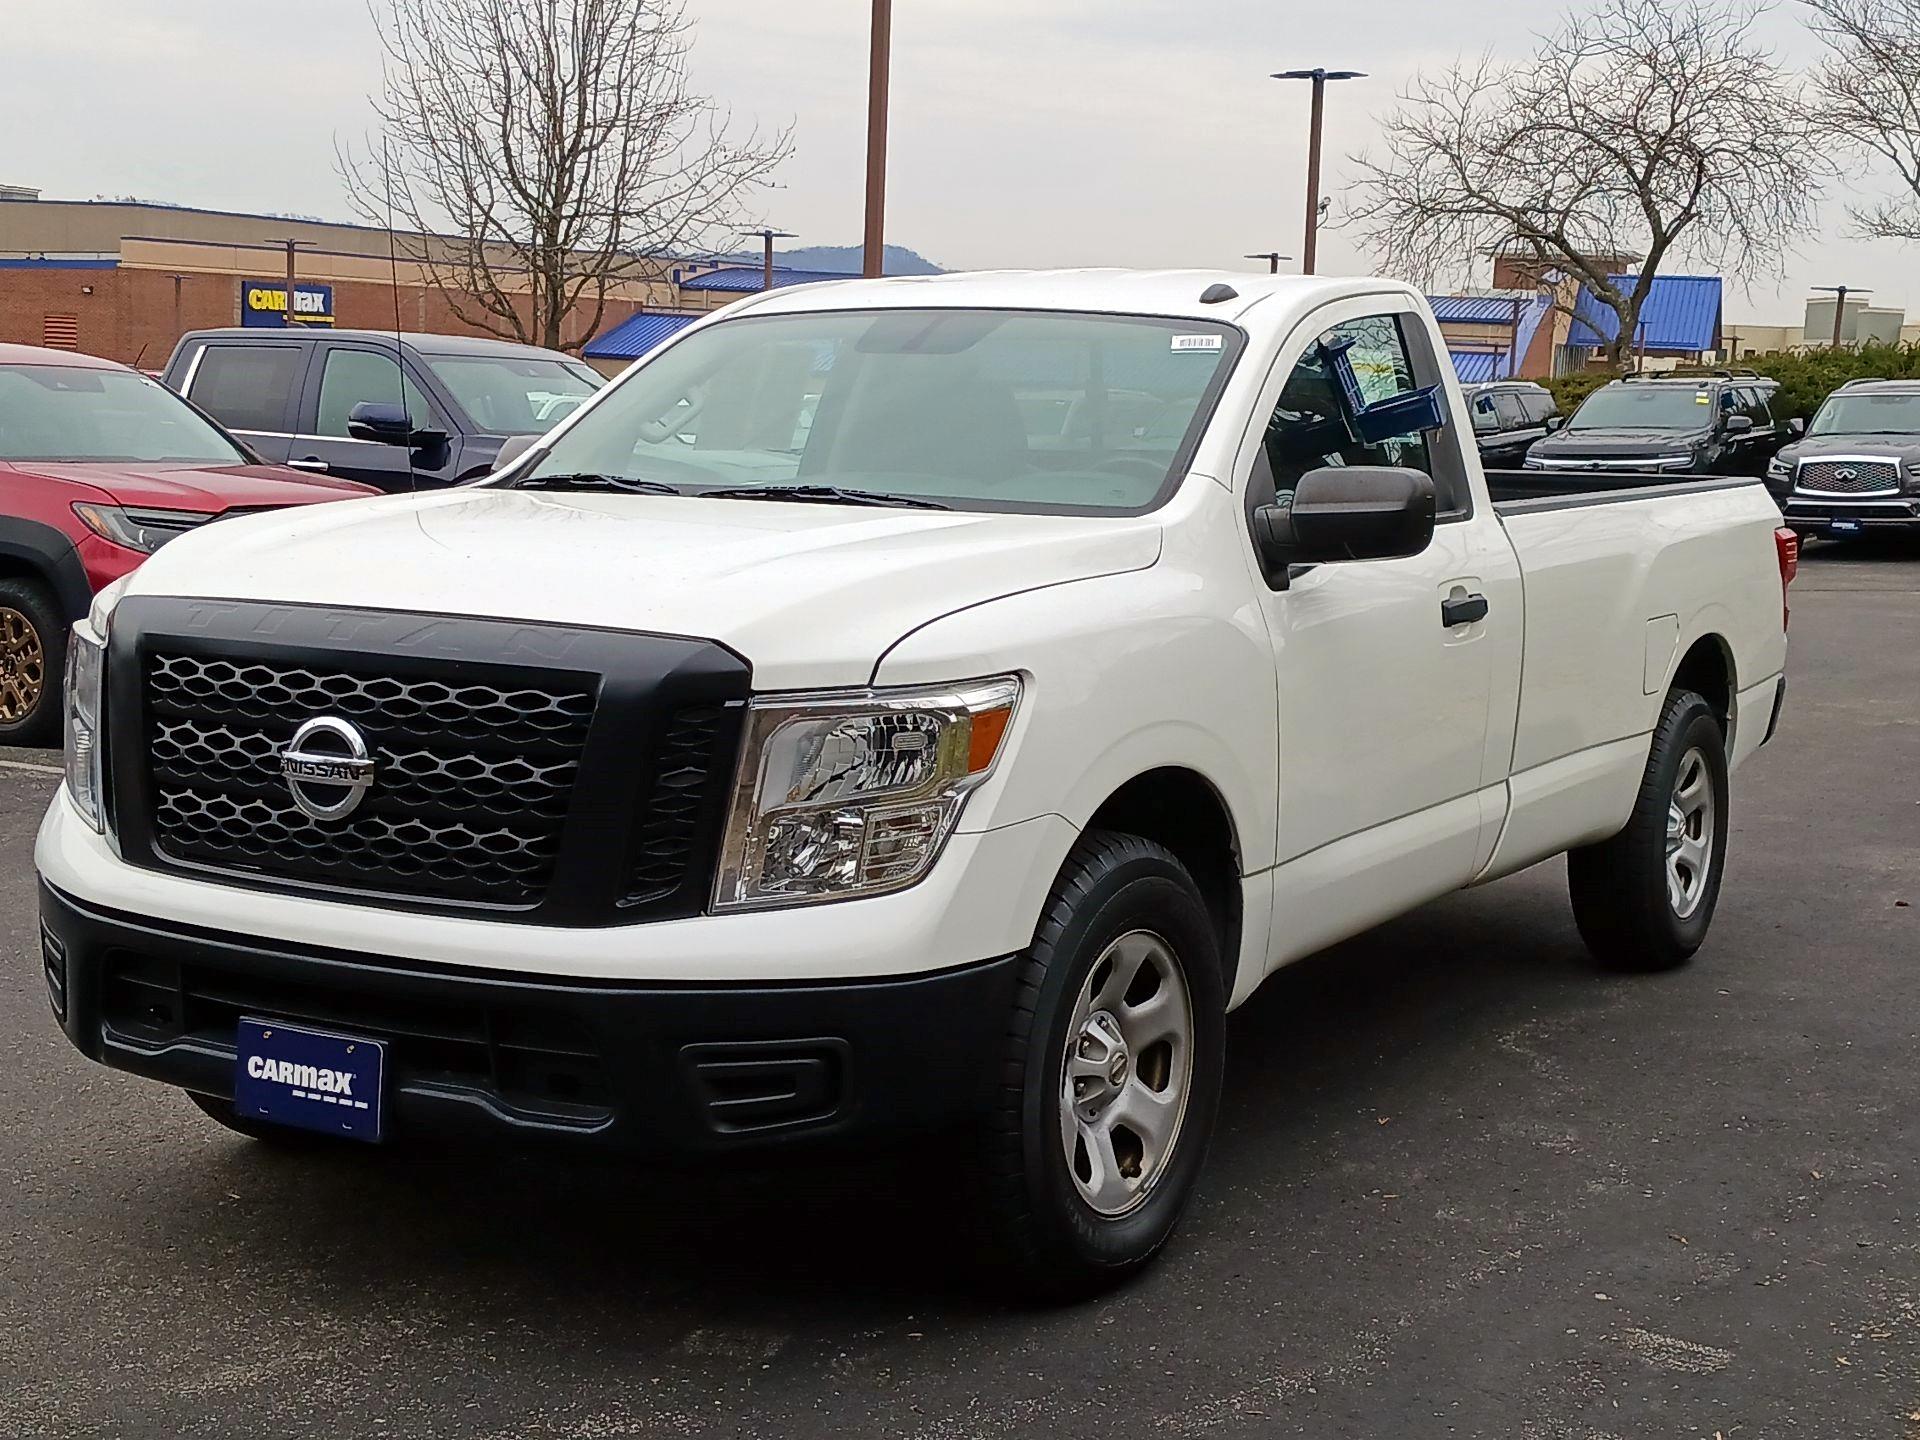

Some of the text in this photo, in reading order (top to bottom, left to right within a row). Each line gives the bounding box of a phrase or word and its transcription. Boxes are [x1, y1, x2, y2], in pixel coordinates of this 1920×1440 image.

[187, 602, 583, 660] TITAN
[282, 759, 362, 781] NISSAN
[247, 1055, 353, 1095] CARmax
